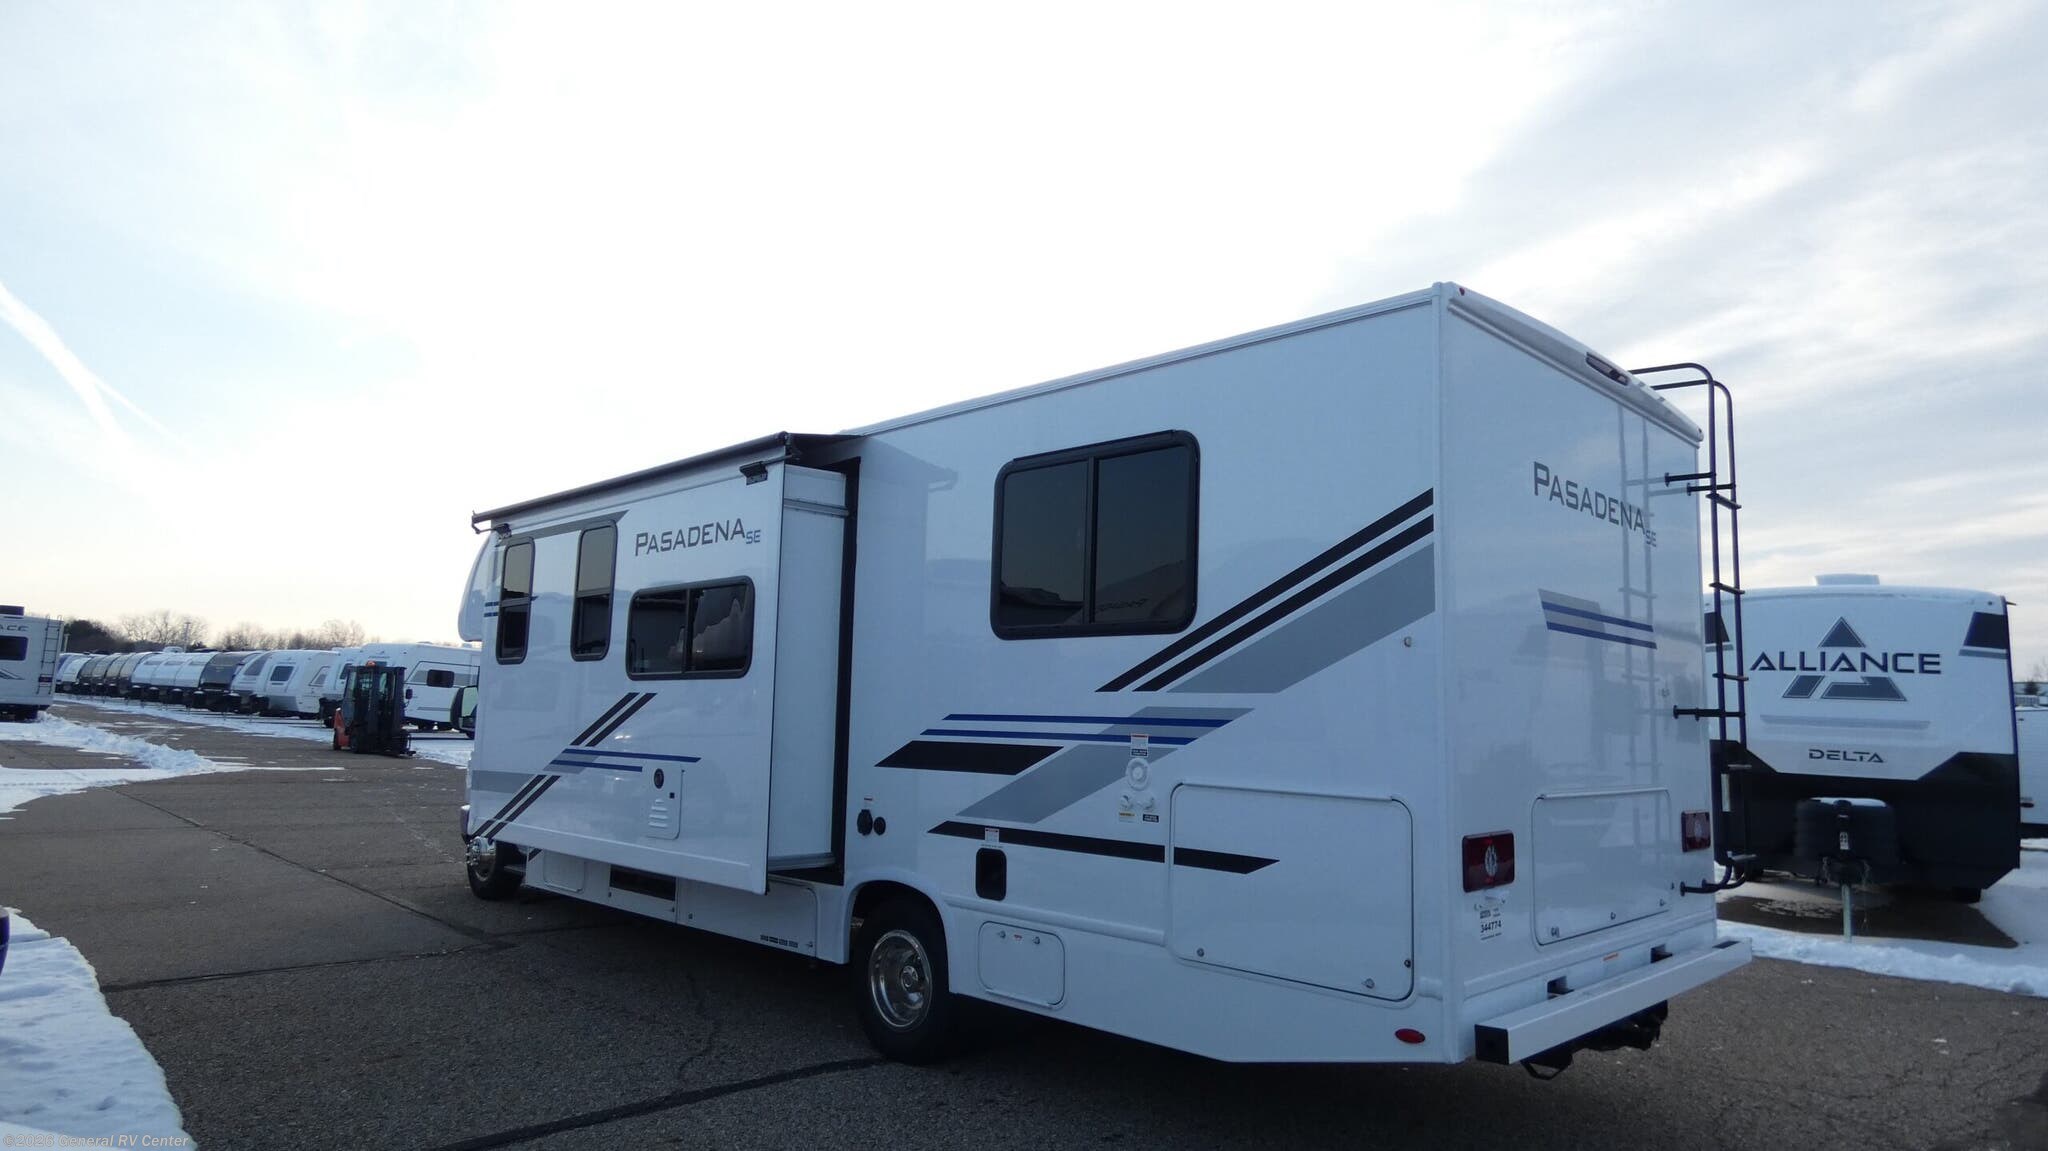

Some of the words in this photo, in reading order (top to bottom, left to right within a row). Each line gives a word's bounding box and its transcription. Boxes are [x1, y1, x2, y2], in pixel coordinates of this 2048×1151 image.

[1534, 461, 1646, 535] PASADENA
[635, 518, 745, 557] PASADENA
[745, 529, 761, 544] SE
[1750, 651, 1942, 675] ALLIANCE
[1808, 748, 1884, 763] DELTA
